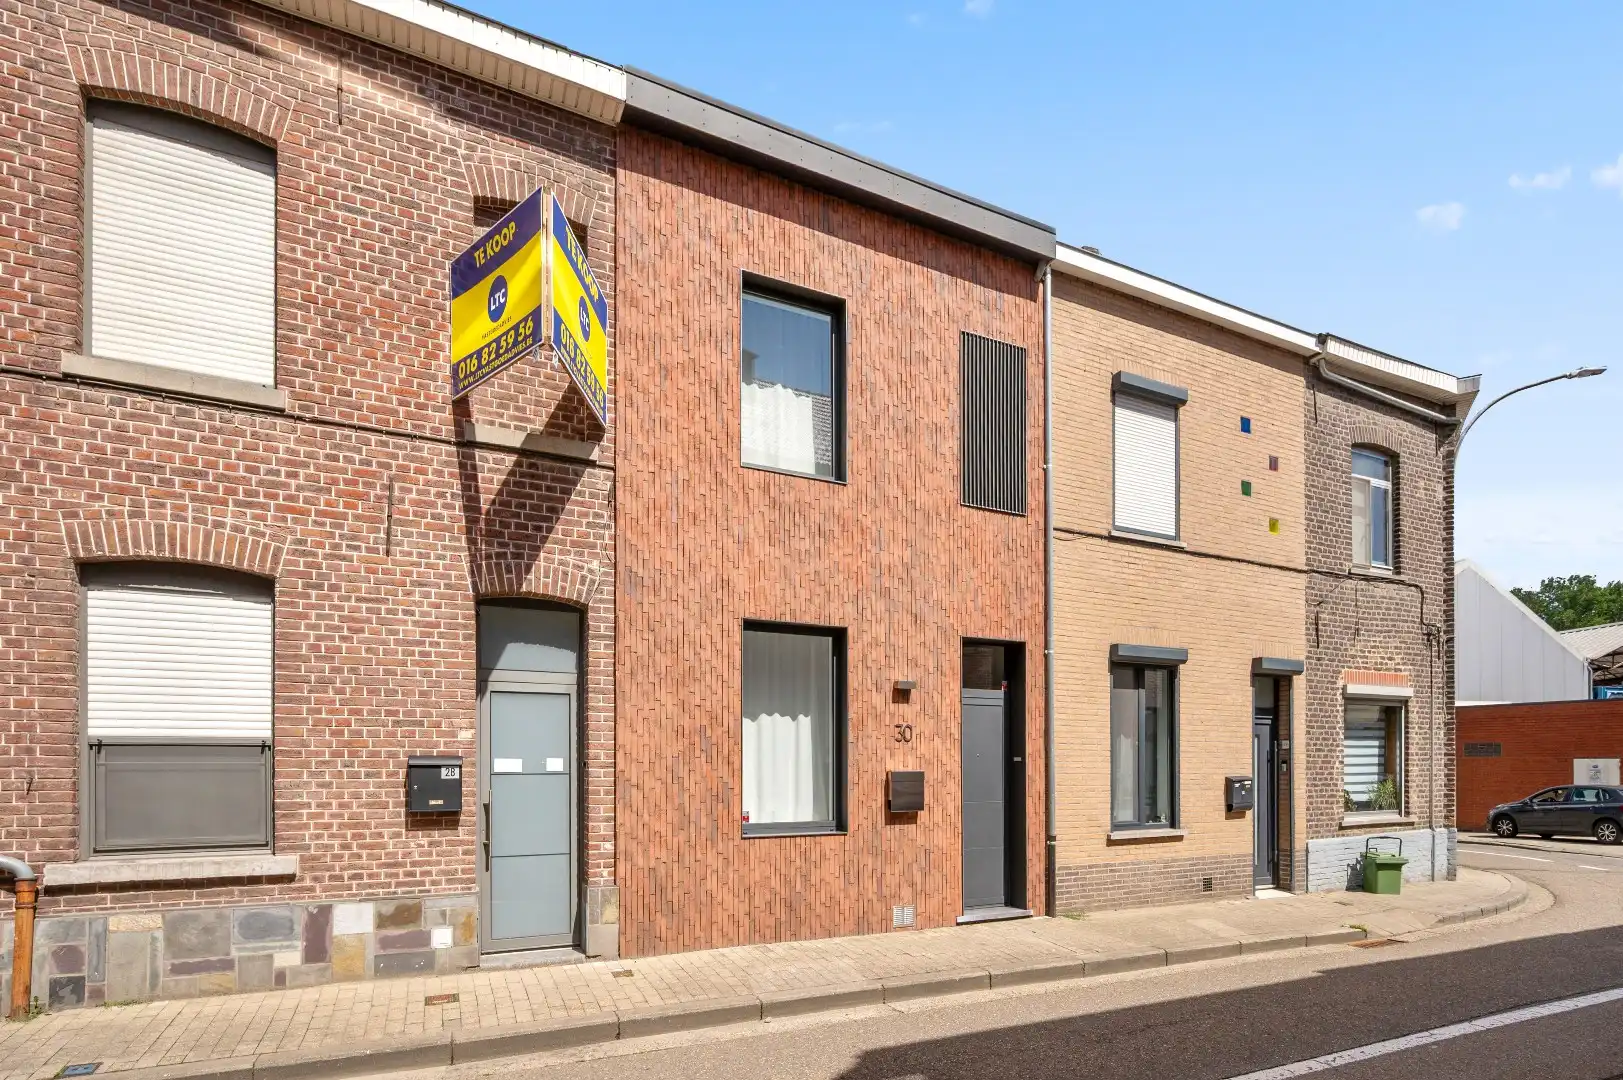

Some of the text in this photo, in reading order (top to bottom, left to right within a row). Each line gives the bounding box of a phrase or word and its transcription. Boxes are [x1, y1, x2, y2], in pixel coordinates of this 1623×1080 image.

[474, 221, 516, 268] TE KOOP
[565, 224, 599, 302] TE KOOP
[490, 288, 506, 312] LTC
[580, 306, 590, 332] LTC
[458, 315, 534, 379] 016 82 59 56
[894, 723, 913, 743] 30
